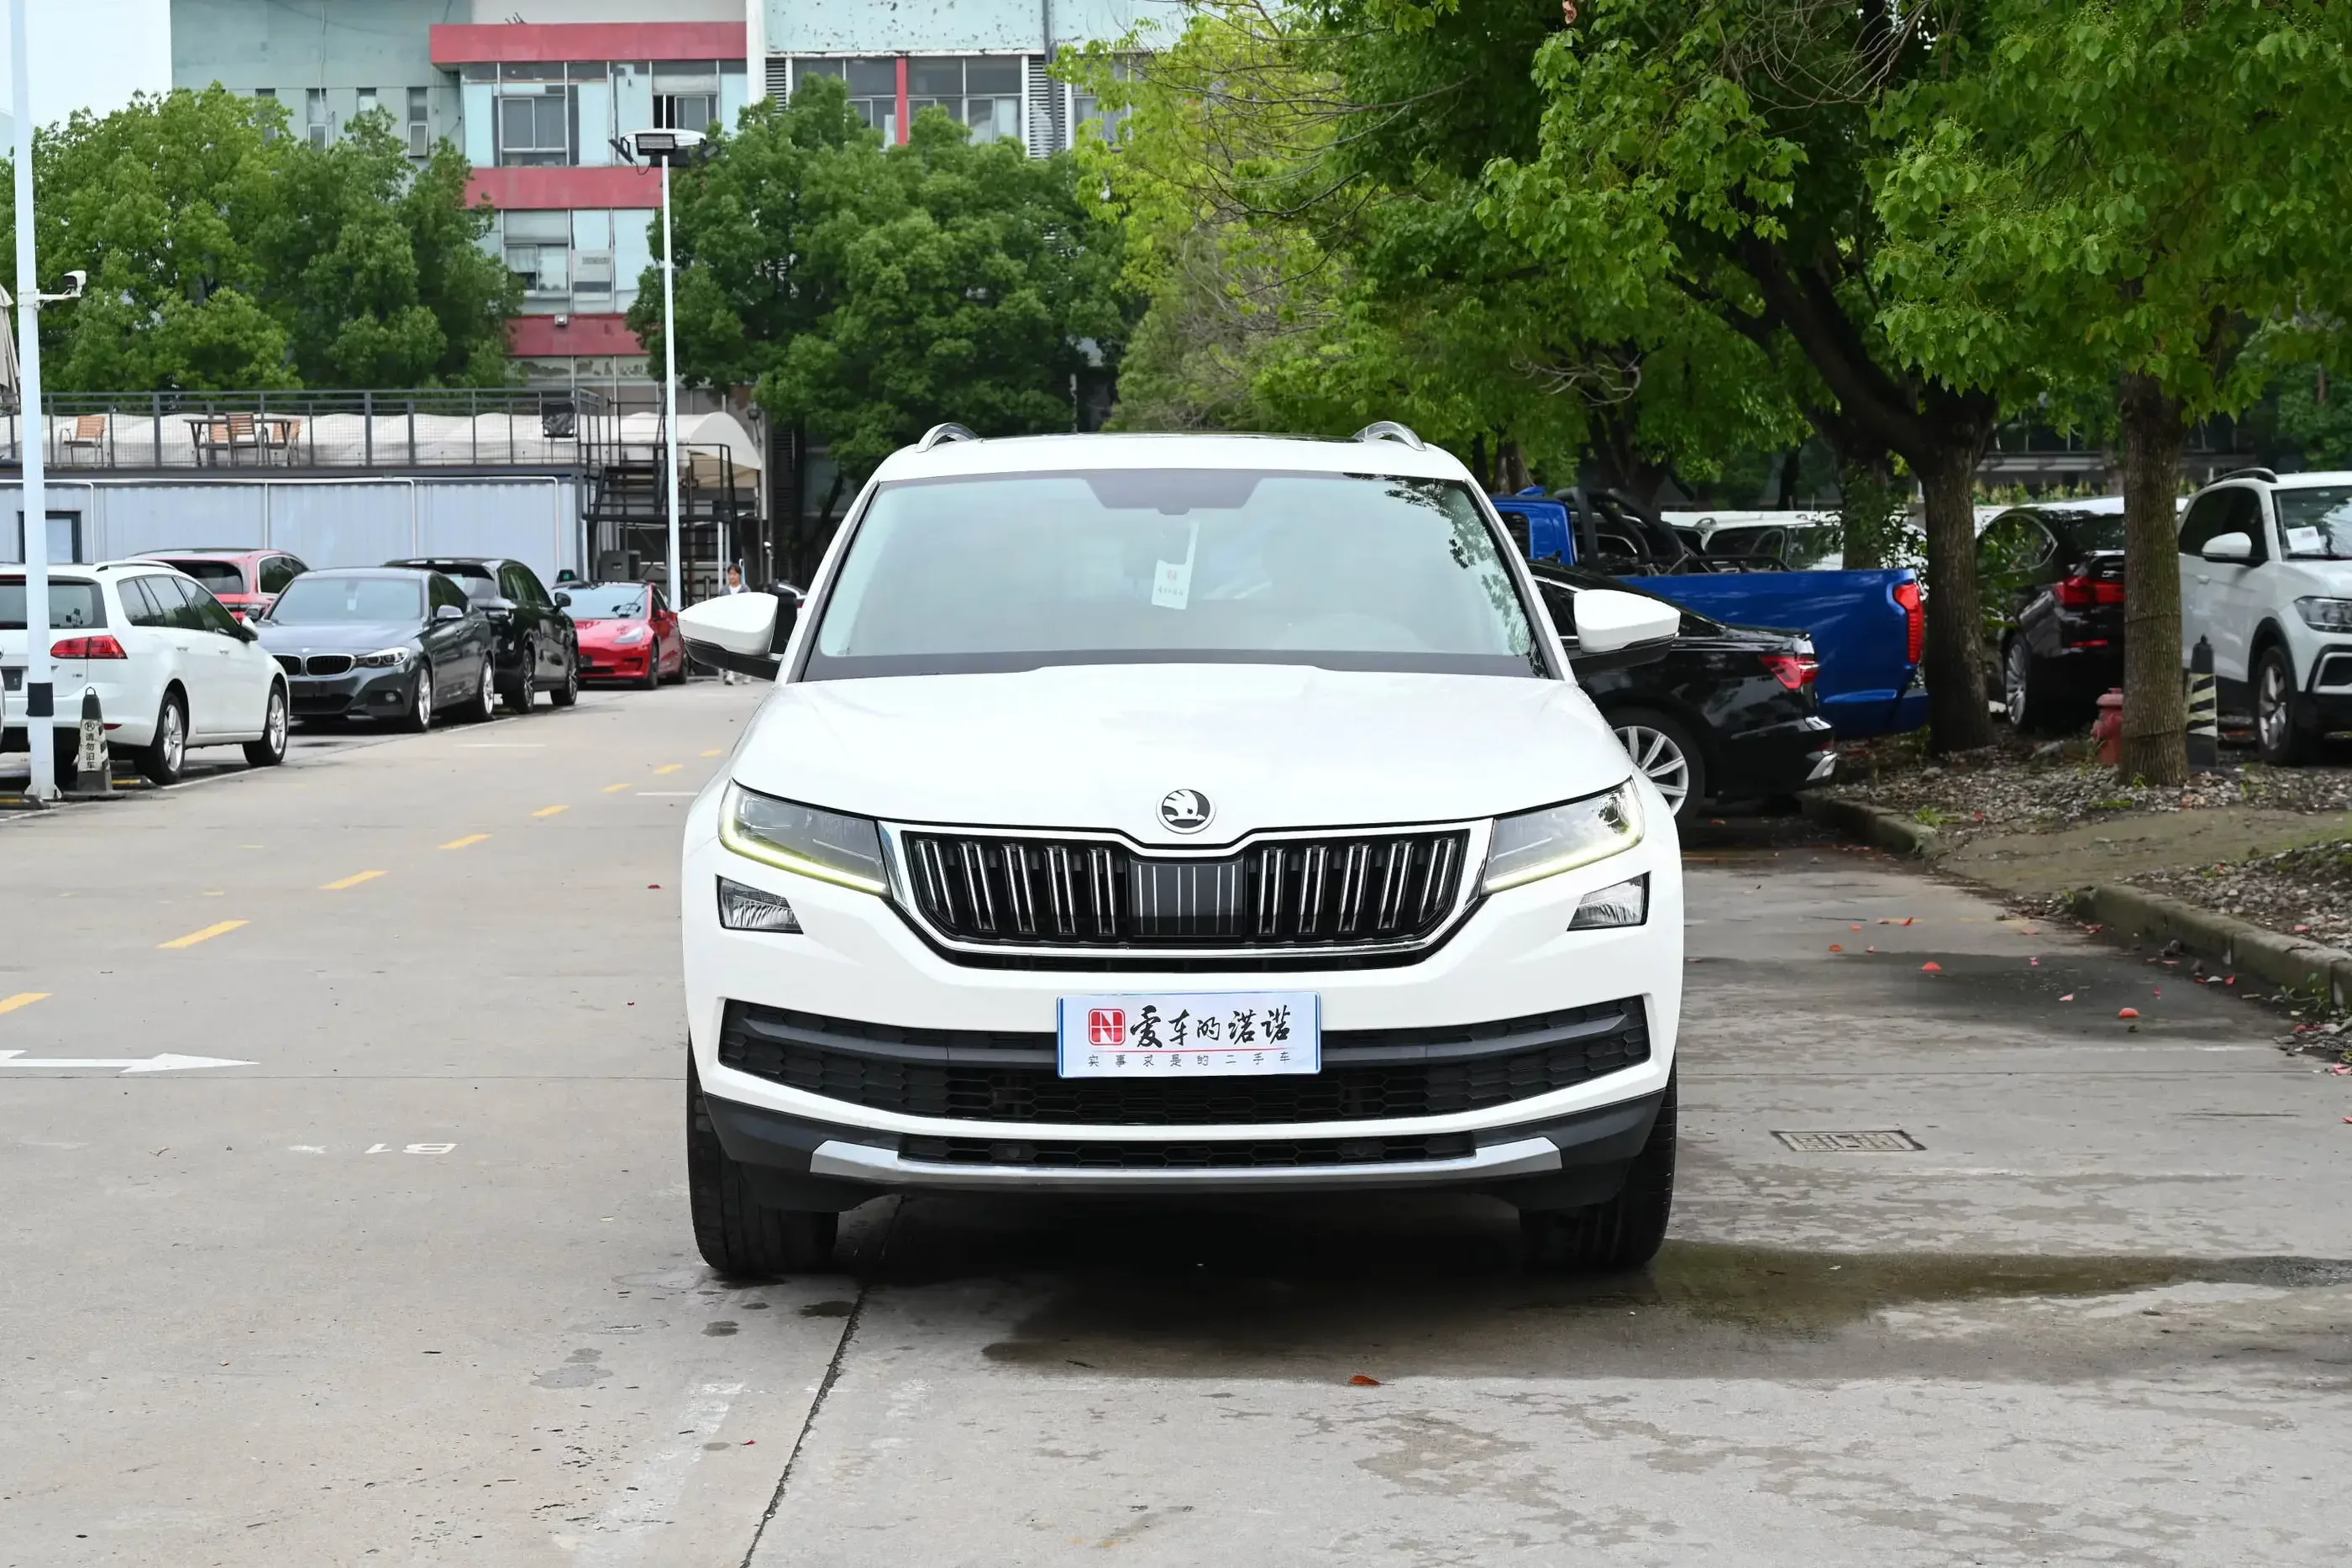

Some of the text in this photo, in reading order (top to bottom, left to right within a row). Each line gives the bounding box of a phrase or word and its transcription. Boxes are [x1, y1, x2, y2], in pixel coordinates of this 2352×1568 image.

[1088, 1051, 1292, 1067] 实事求是的二手车
